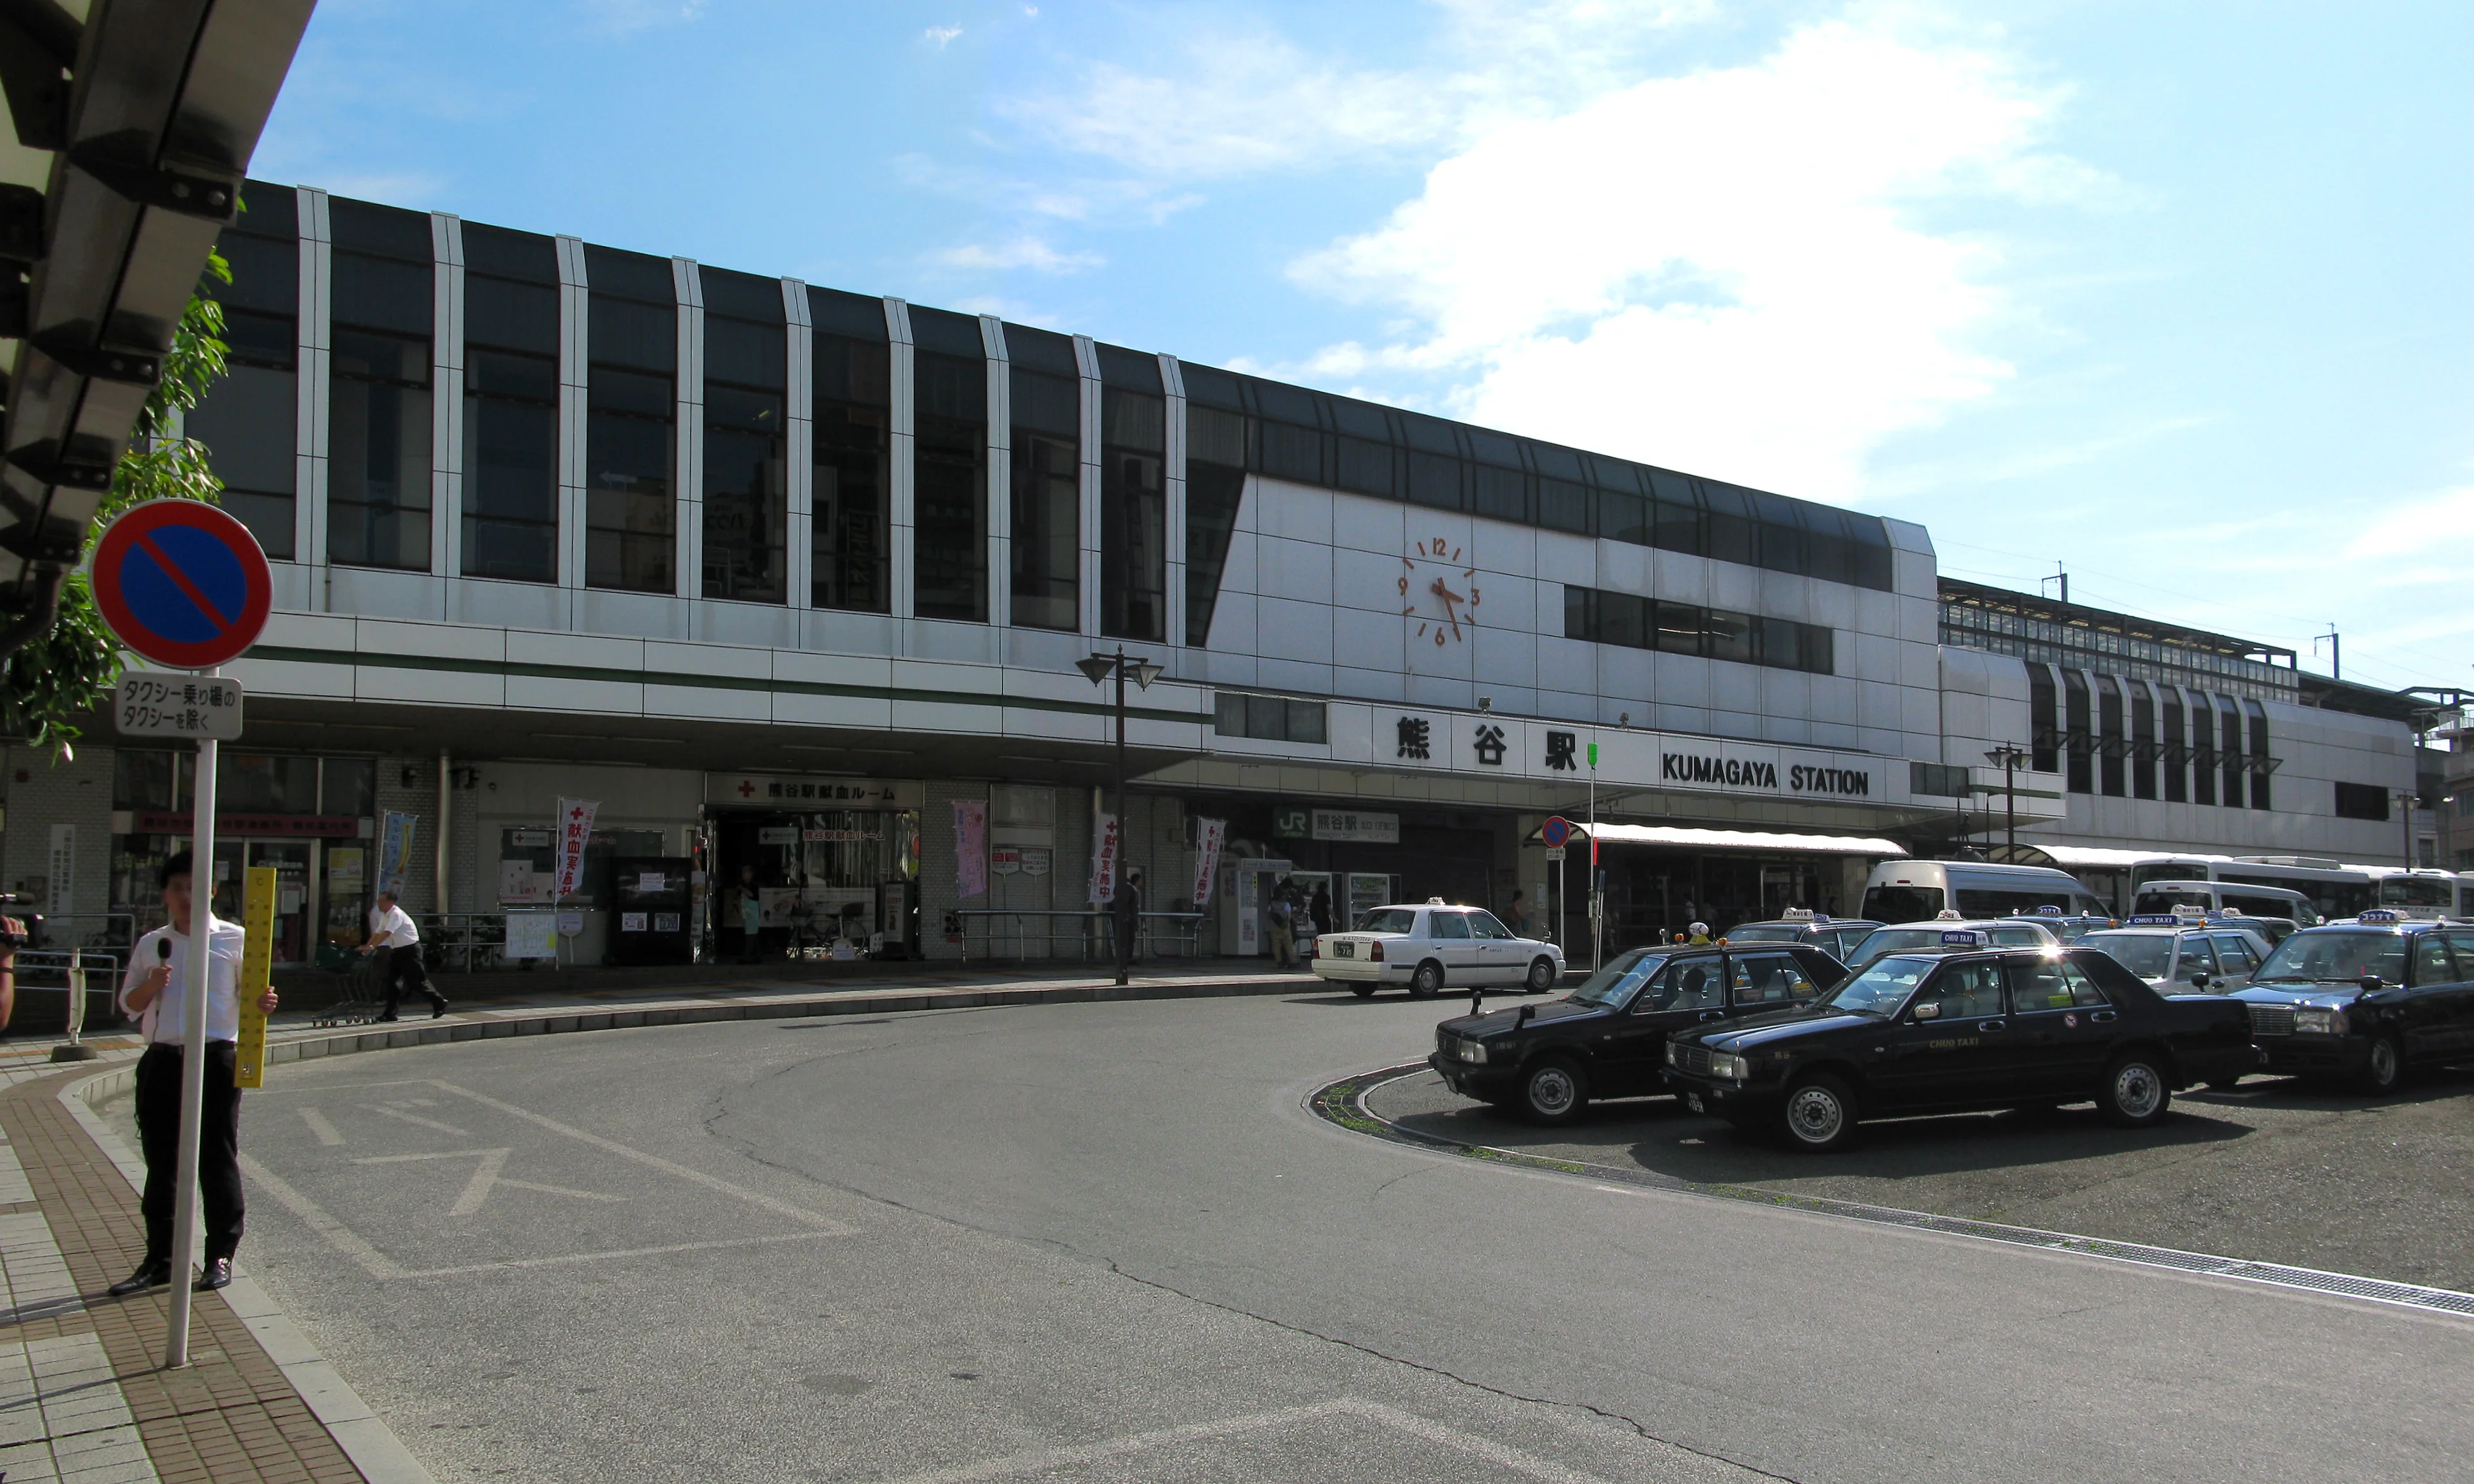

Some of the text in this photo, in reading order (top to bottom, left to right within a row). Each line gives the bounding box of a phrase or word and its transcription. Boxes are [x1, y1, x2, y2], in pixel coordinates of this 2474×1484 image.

[1433, 537, 1446, 556] 12
[1398, 578, 1408, 596] 9
[1471, 589, 1480, 606] 3
[1435, 626, 1445, 647] 6
[125, 681, 235, 707] タクシー乗り場の
[124, 706, 208, 730] タクシーを除く
[1397, 716, 1577, 771] 熊谷駅
[1663, 753, 1868, 796] KUMAGAYA STATION
[768, 782, 895, 801] 熊谷駅献血ルーム
[1279, 812, 1306, 831] JR
[1317, 814, 1357, 831] 熊谷駅
[802, 830, 885, 842] 熊谷駅献血ルーム
[1959, 934, 1972, 942] TAXI
[1929, 1037, 1979, 1048] CHUO TAXI
